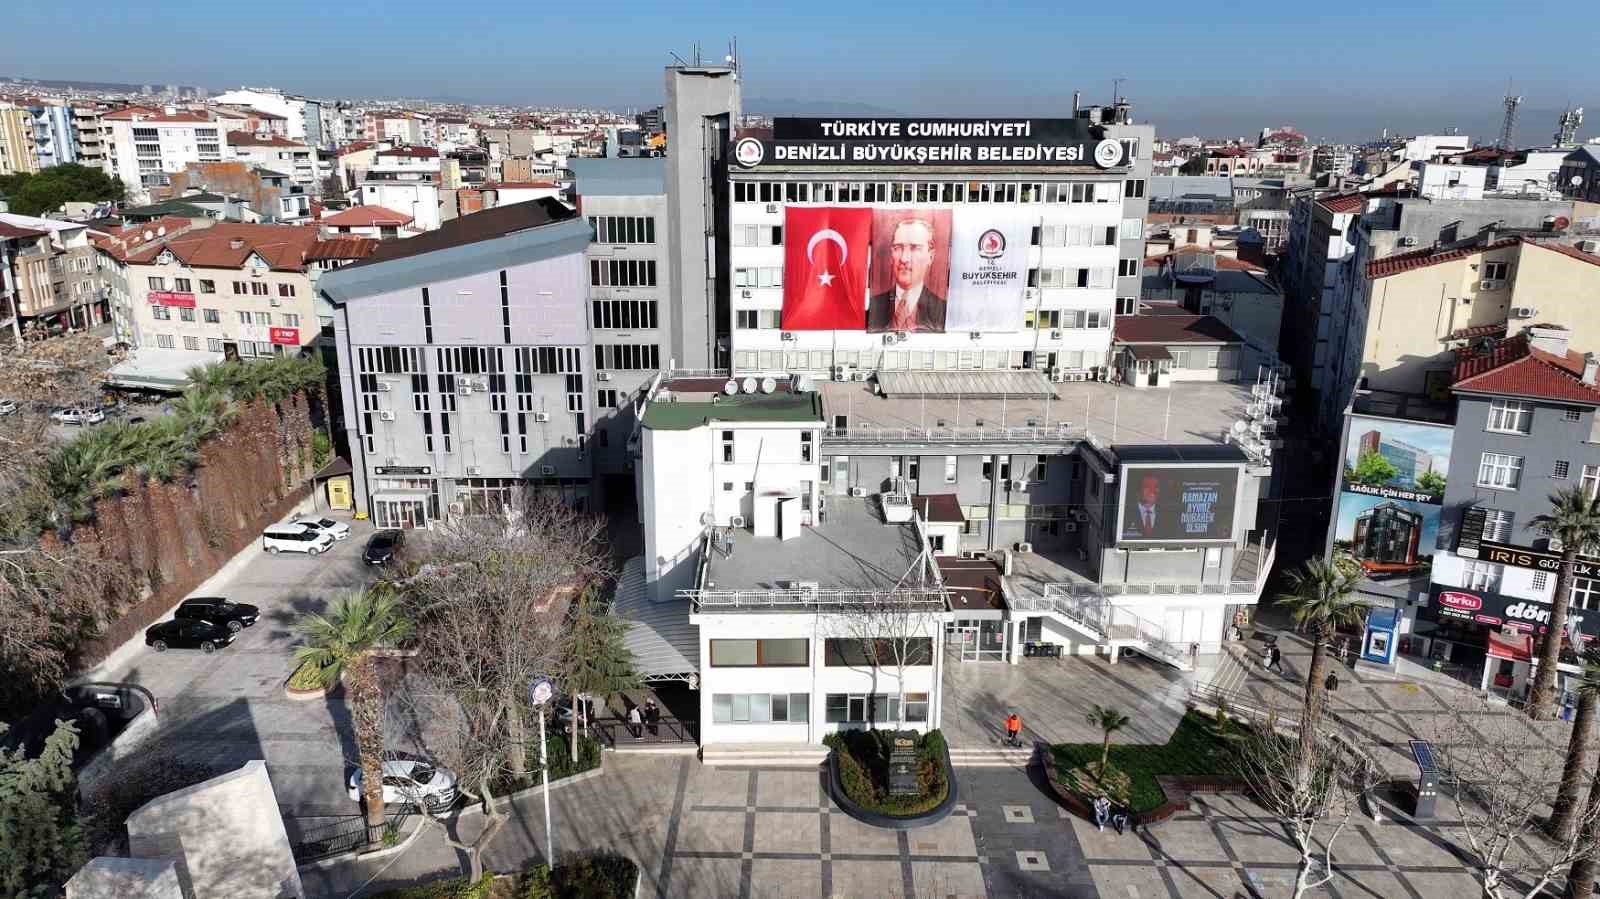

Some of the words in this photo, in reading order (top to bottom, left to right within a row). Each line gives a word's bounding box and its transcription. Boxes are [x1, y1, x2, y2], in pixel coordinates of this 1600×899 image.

[821, 120, 900, 136] TÜRKİYE
[907, 120, 1031, 137] CUMHURİYETİ
[775, 144, 845, 160] DENİZLİ
[853, 144, 972, 163] BÜYÜKŞEHİR
[977, 144, 1084, 160] BELEDİYESİ
[1350, 484, 1379, 495] SAĞLIK
[1380, 487, 1397, 498] İÇİN
[1399, 492, 1415, 500] HER
[1416, 494, 1432, 502] ŞEY
[1490, 550, 1532, 566] IRIS
[1538, 559, 1592, 575] GÜZLİK
[1444, 593, 1476, 608] Torku
